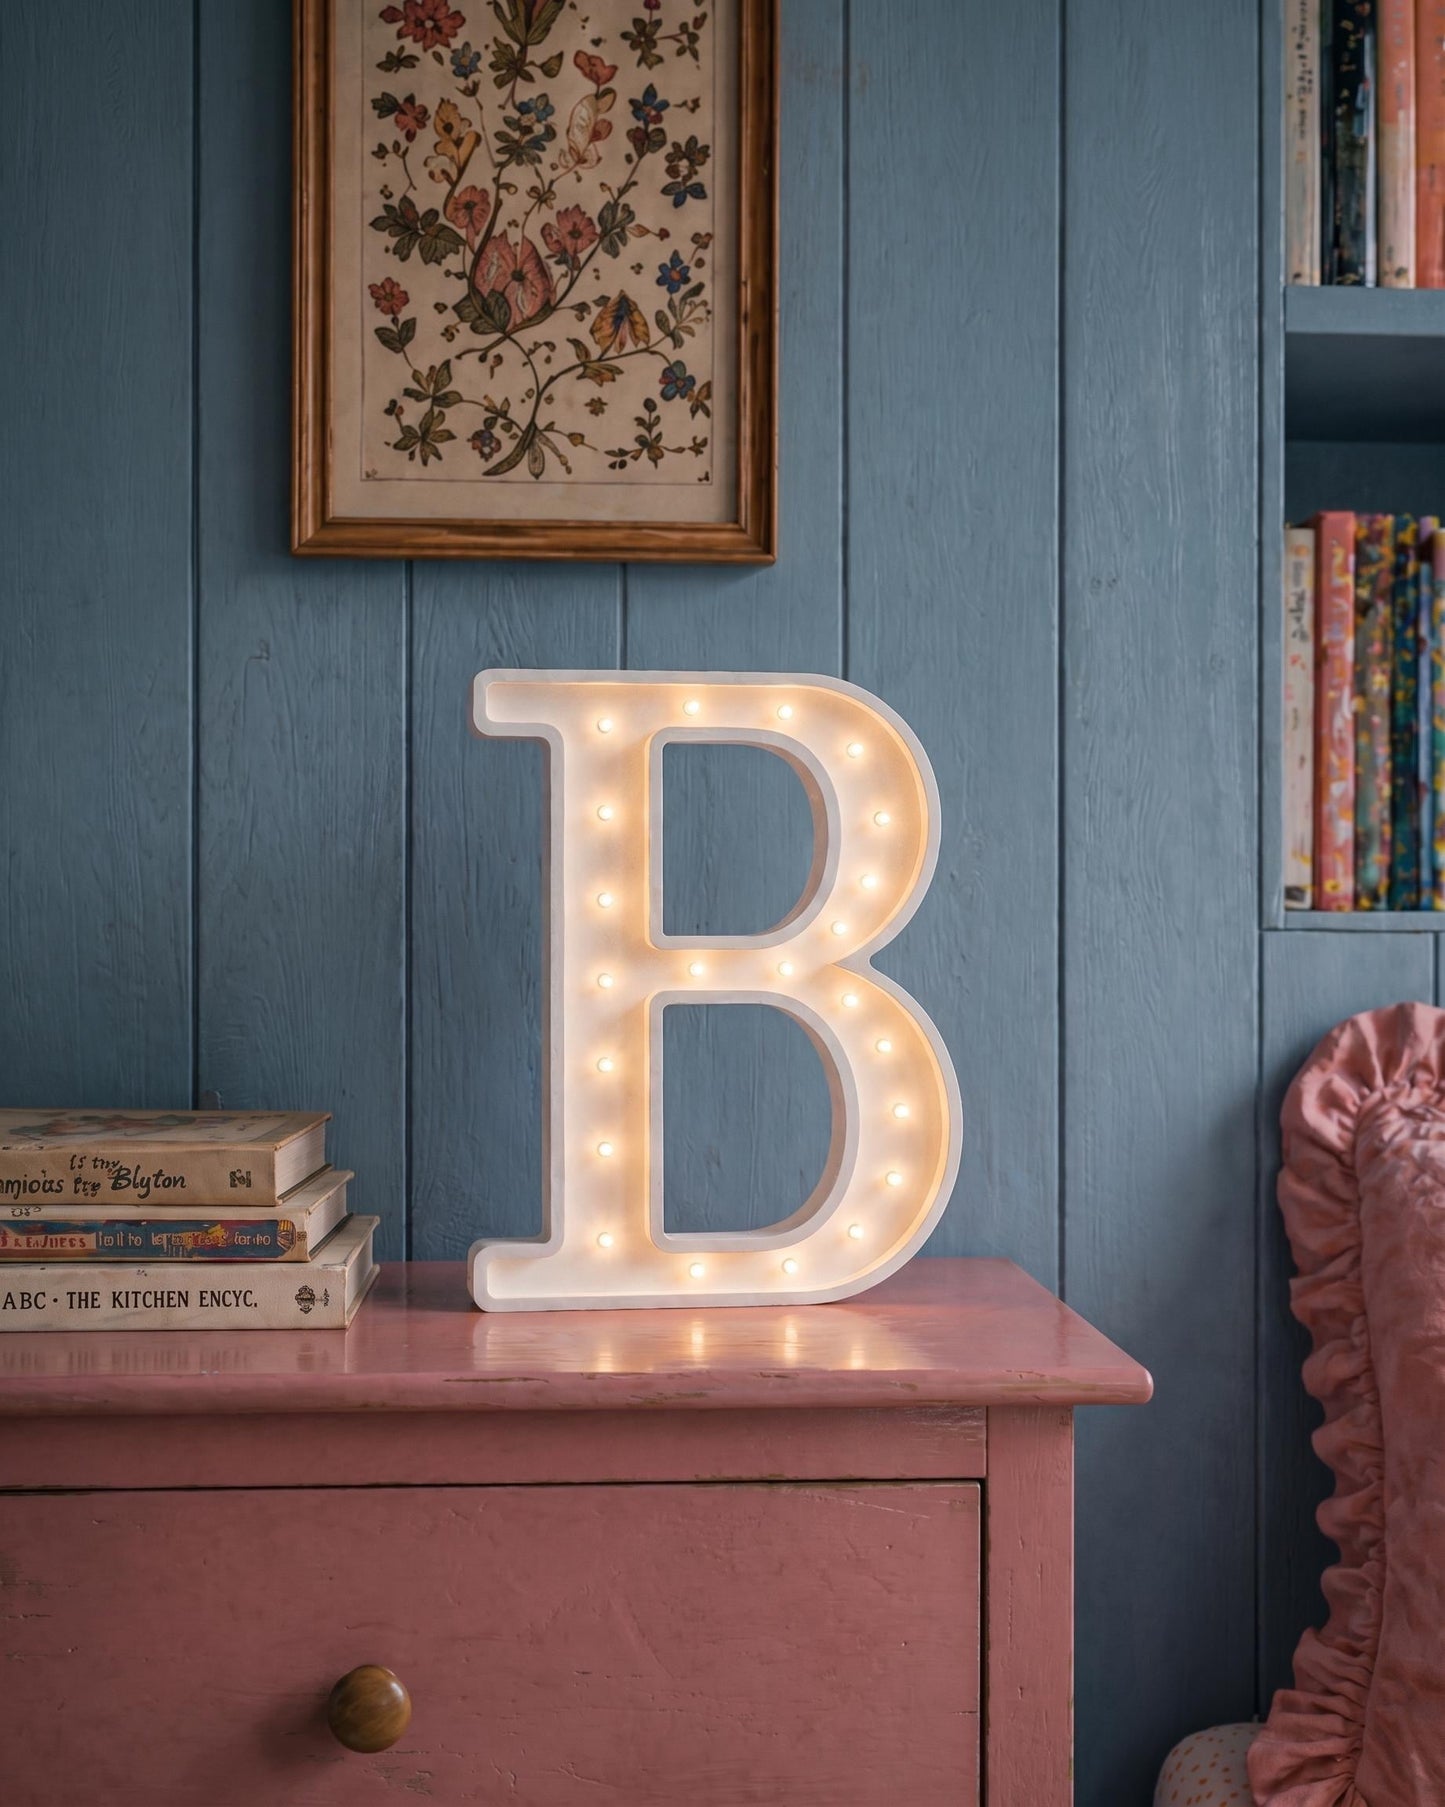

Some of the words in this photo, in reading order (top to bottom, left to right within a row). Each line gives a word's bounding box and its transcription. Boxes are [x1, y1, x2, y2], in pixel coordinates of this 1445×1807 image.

[468, 668, 963, 1313] B
[110, 1164, 187, 1199] Blyton
[2, 1291, 46, 1310] ABC
[66, 1291, 101, 1309] THE
[111, 1290, 190, 1309] KITCHEN
[199, 1289, 258, 1308] ENCYC.
